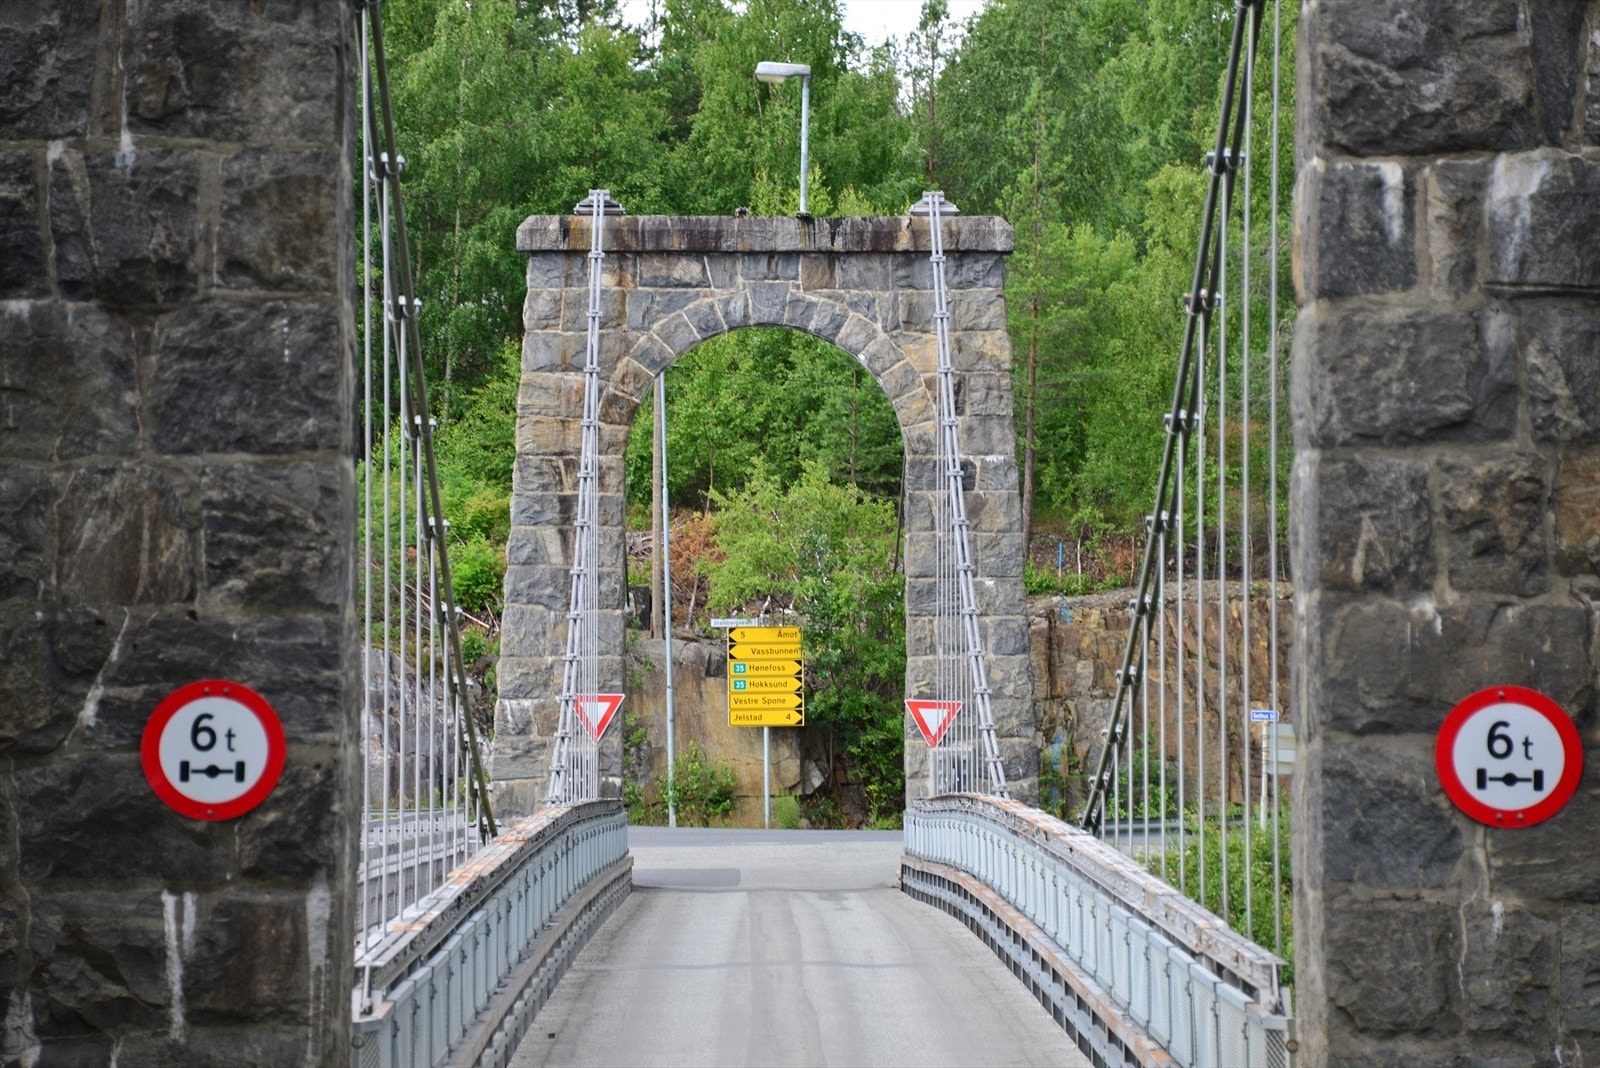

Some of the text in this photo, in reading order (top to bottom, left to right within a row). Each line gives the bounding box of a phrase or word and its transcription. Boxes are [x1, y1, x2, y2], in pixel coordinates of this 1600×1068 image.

[777, 629, 798, 638] Åmot
[751, 647, 799, 655] Vassbunnen
[735, 664, 745, 672] 35
[735, 681, 745, 689] 35
[733, 697, 786, 706] Vestre Spone
